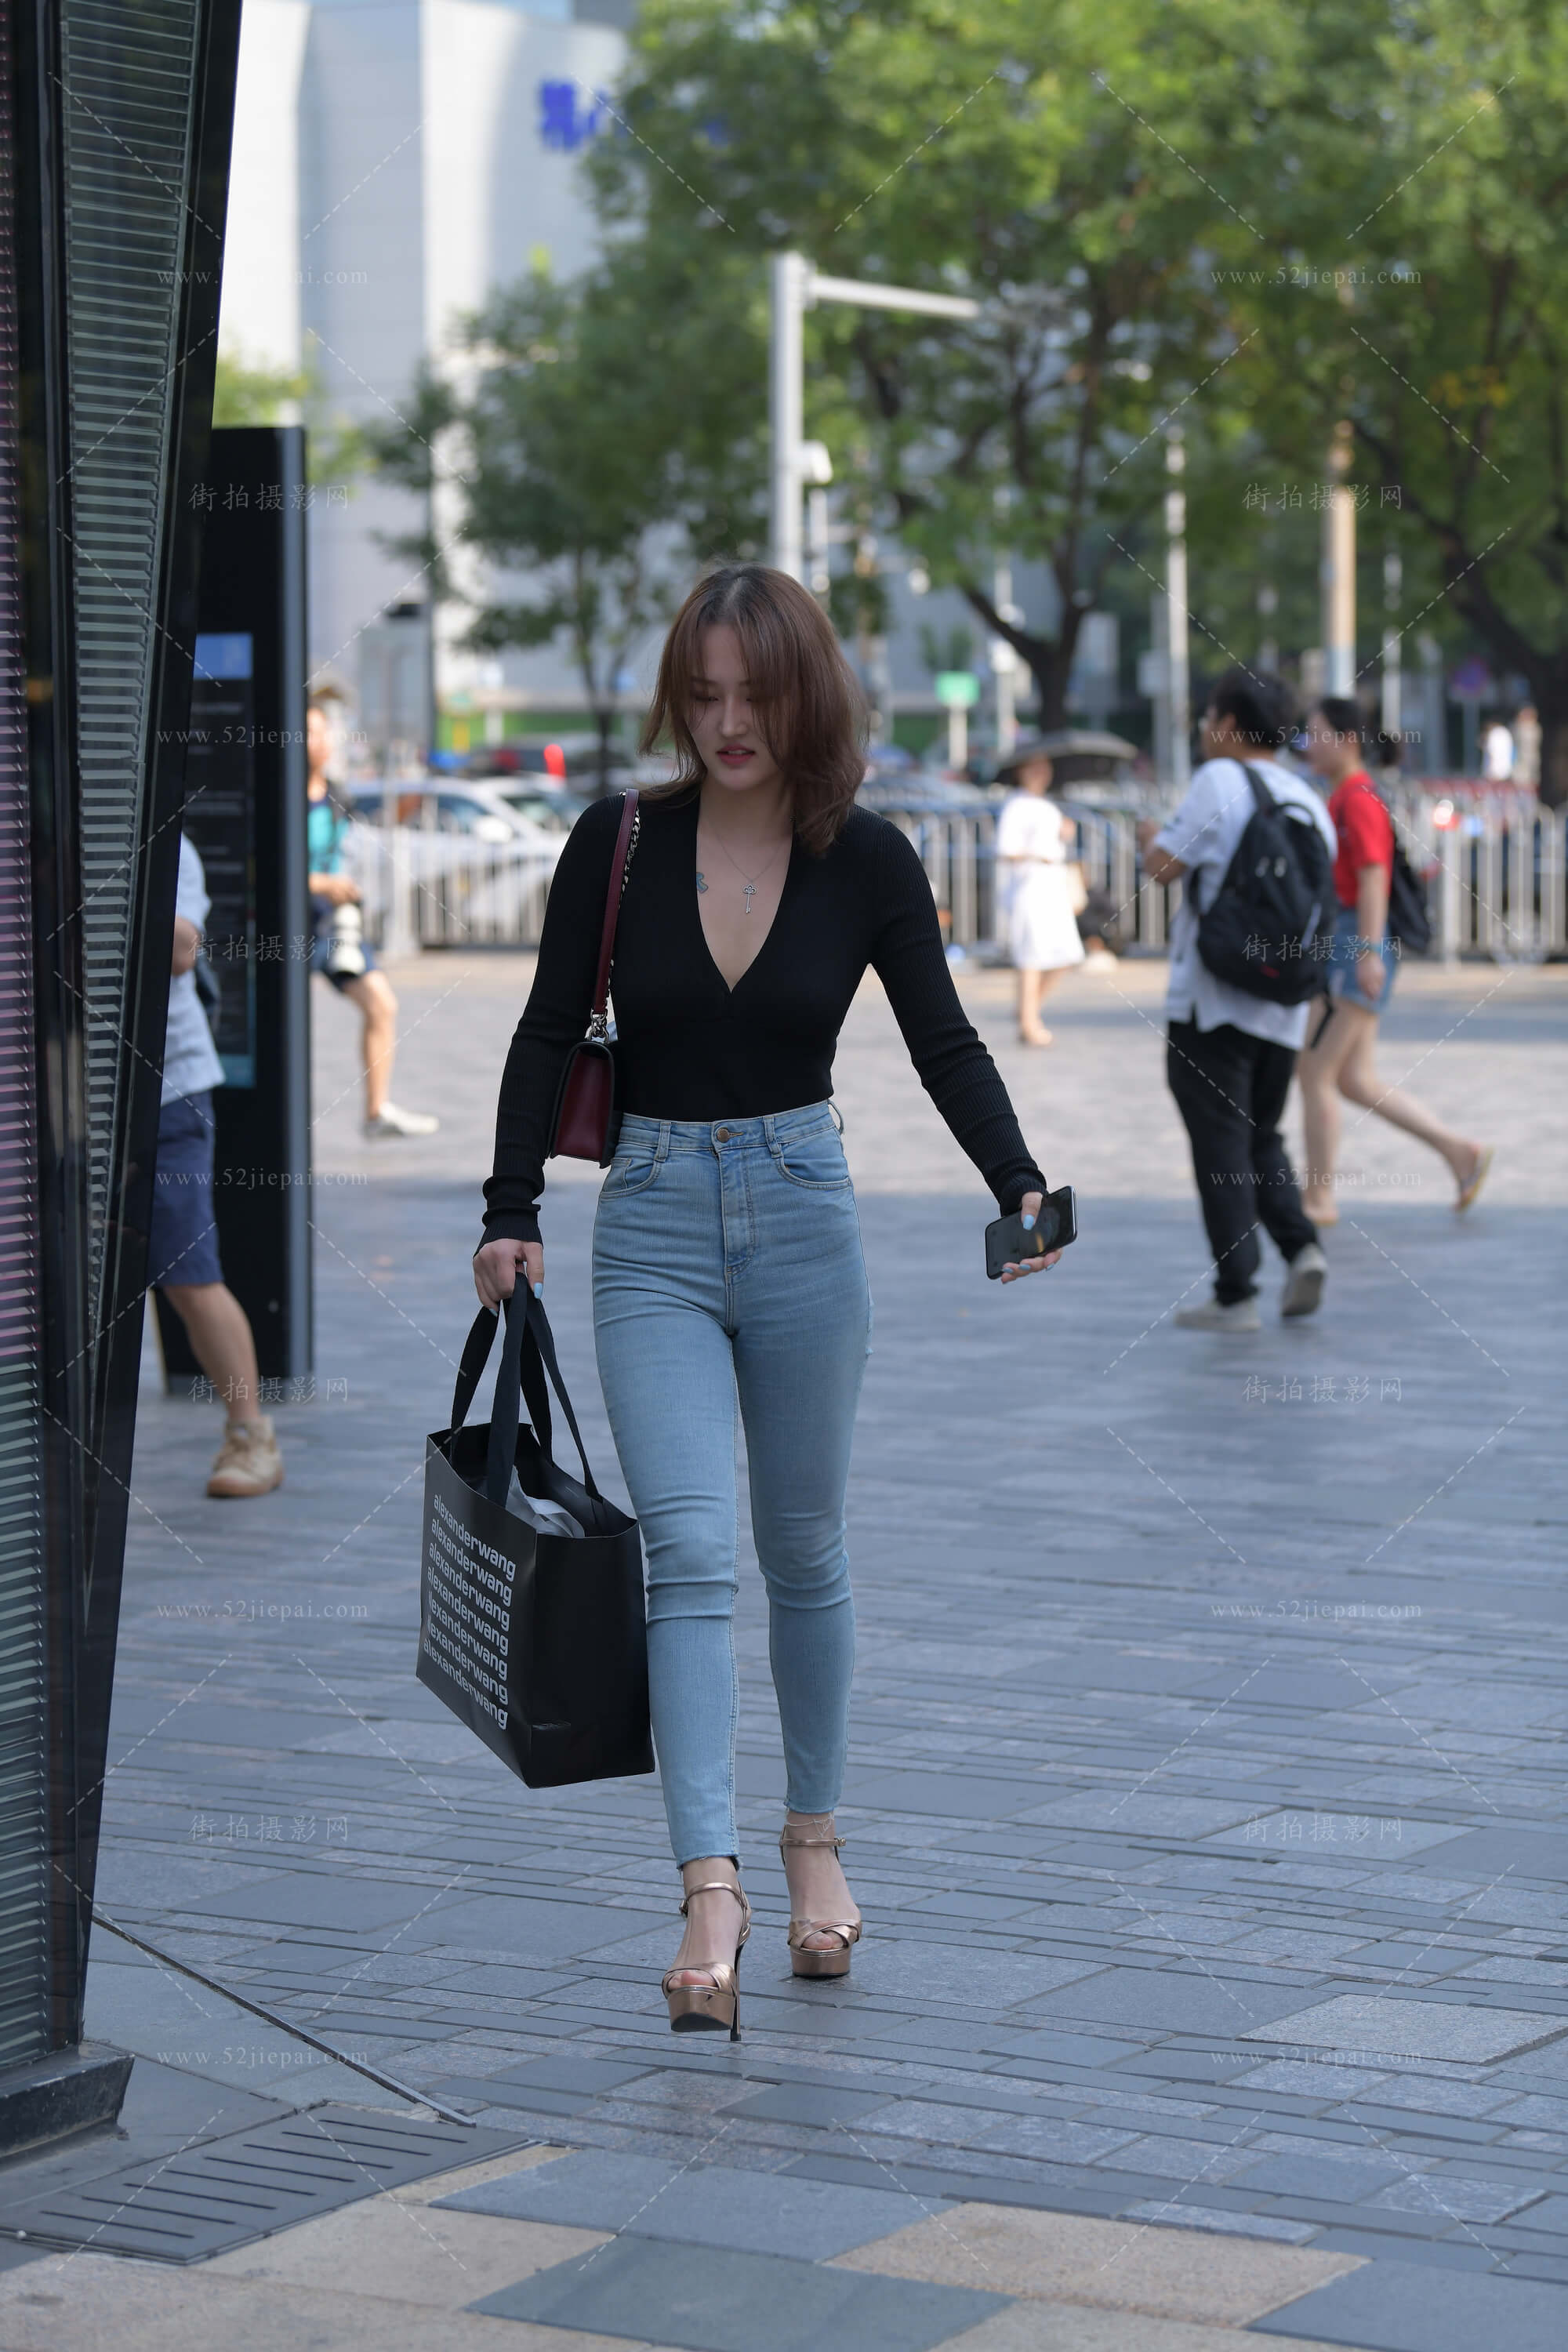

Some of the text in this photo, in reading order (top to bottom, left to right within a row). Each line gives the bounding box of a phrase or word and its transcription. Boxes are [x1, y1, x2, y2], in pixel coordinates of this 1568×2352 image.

[430, 1516, 514, 1606] alexanderwang
[434, 1492, 516, 1581] alexanderwang
[426, 1565, 509, 1657] alexanderwang
[428, 1541, 510, 1632] alexanderwang
[423, 1639, 509, 1730] alexanderwang
